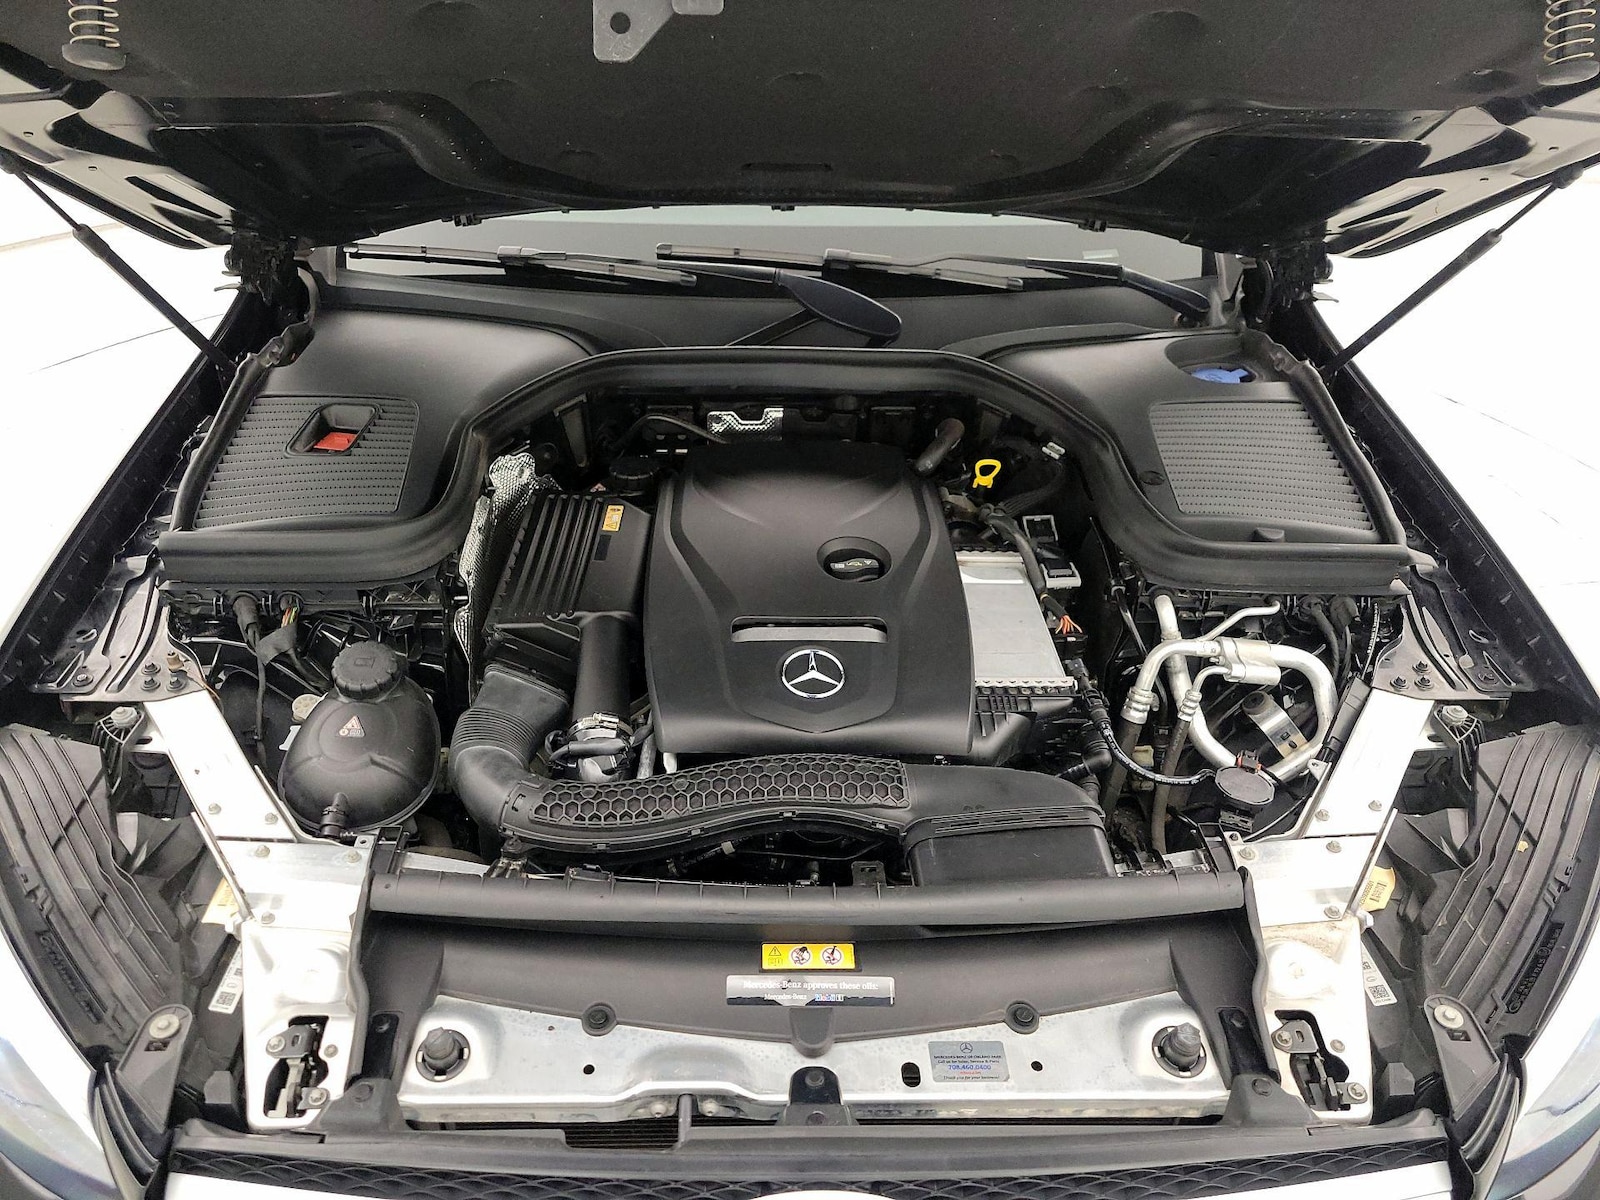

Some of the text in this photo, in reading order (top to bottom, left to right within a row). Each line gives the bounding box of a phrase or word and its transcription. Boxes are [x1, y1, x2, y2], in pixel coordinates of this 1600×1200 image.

[743, 980, 802, 989] Mercedes-Benz
[803, 981, 838, 991] approves
[839, 981, 861, 990] these
